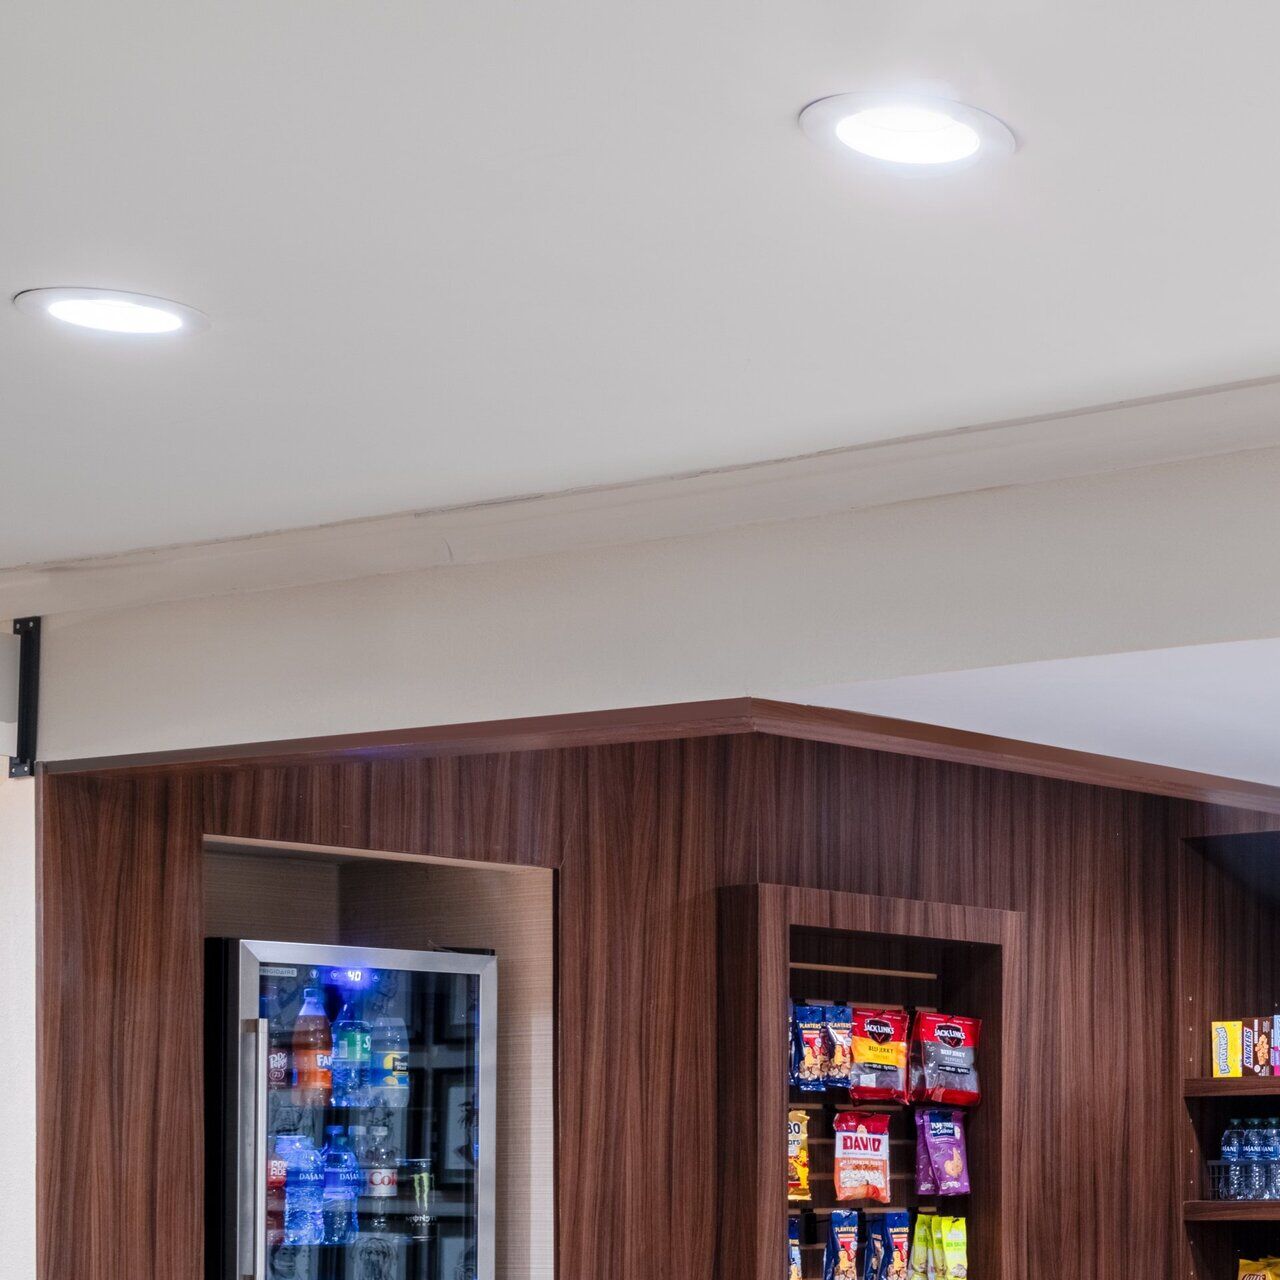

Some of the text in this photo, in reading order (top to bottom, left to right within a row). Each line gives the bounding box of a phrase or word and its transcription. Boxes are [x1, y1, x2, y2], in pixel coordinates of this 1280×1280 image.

[260, 968, 296, 976] RIGIDAIRE
[347, 970, 362, 982] 40
[1244, 1029, 1253, 1066] SNICKERS
[842, 1135, 882, 1152] DAVID
